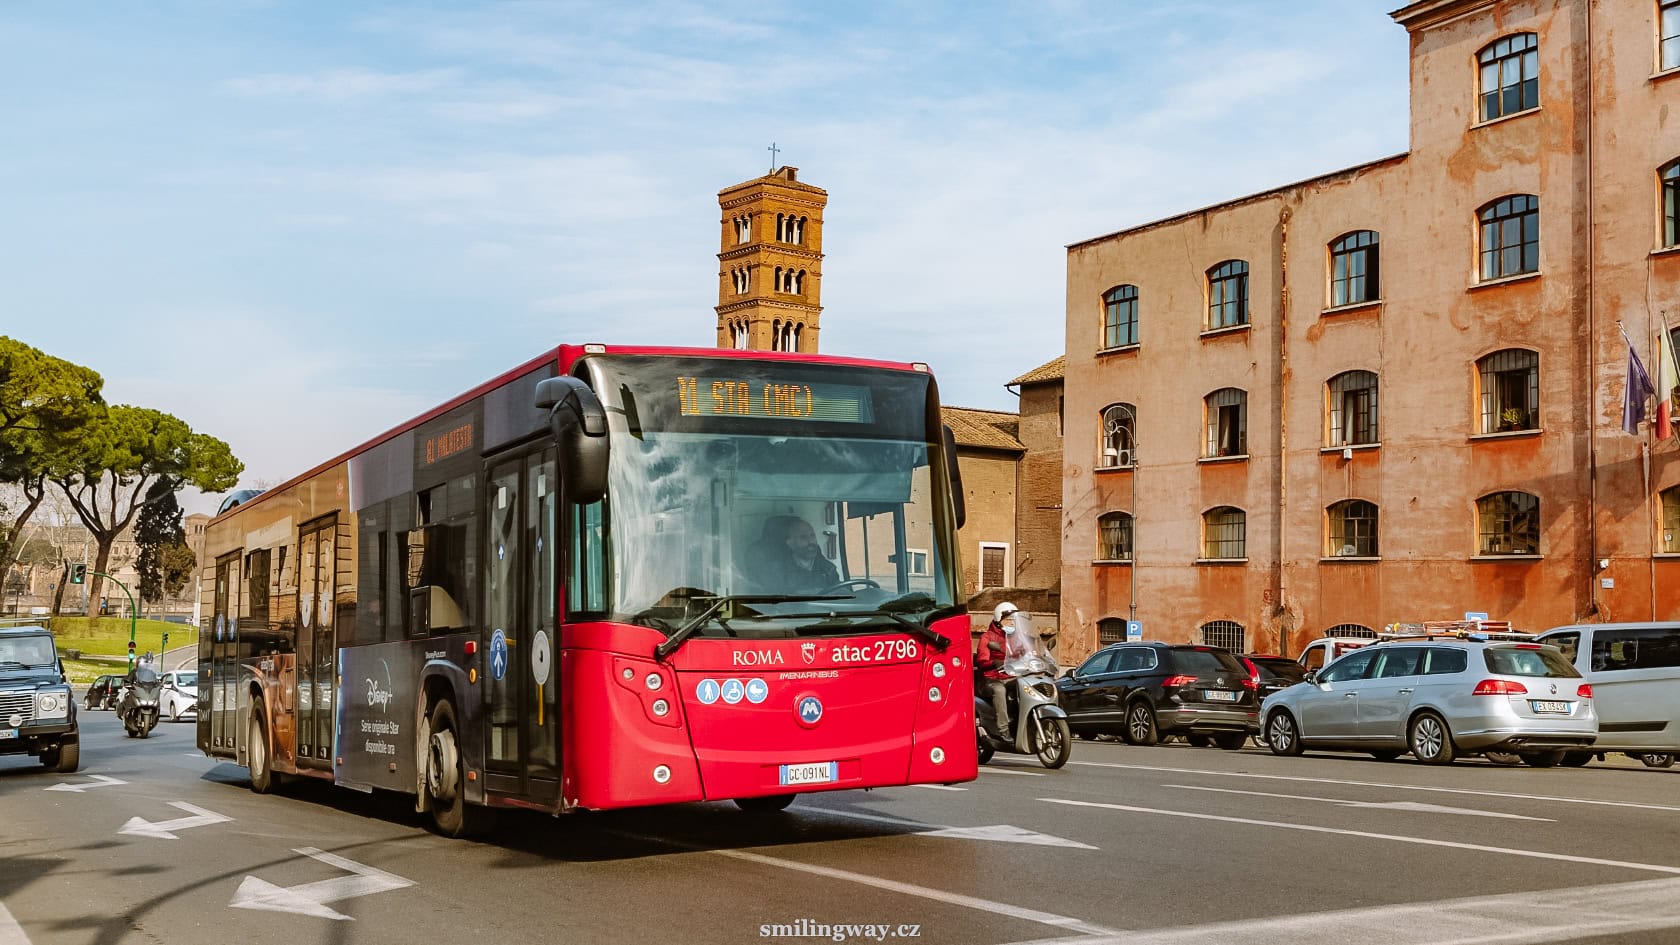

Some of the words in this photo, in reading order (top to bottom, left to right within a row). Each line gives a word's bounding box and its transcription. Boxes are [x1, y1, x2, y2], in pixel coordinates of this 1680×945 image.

[712, 381, 749, 414] STA
[763, 384, 813, 416] (MC)
[733, 650, 784, 665] ROMA
[832, 646, 871, 662] atac
[874, 639, 917, 660] 2796
[366, 678, 393, 713] Disney+
[361, 719, 371, 732] Serie
[372, 720, 389, 736] originale
[390, 721, 399, 734] Star
